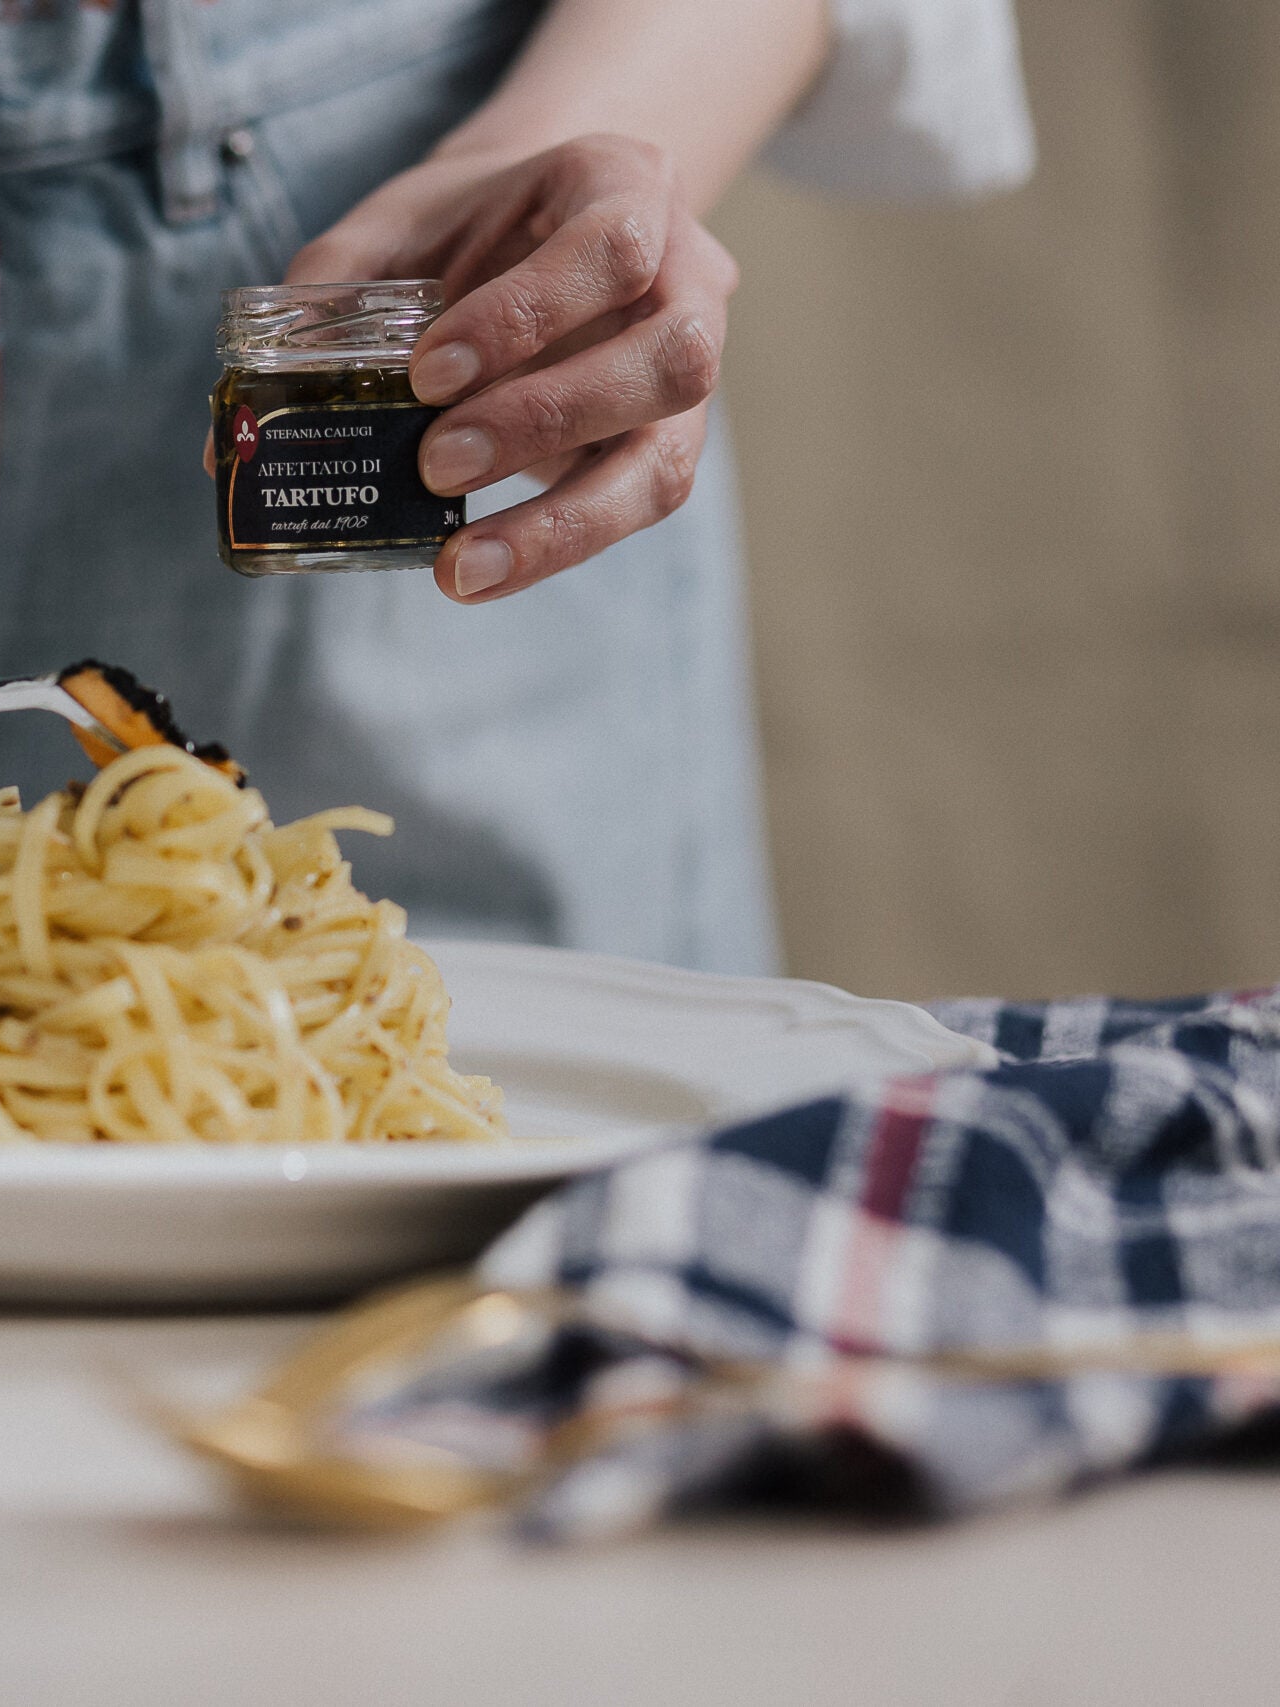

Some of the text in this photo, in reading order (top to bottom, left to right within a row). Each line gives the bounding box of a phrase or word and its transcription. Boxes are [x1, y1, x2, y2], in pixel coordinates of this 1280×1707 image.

[265, 426, 373, 440] STEFANIA CALUGI
[258, 459, 381, 477] AFFETTATO DI
[261, 485, 379, 507] TARTUFO
[271, 516, 369, 533] tartufi dal 1908
